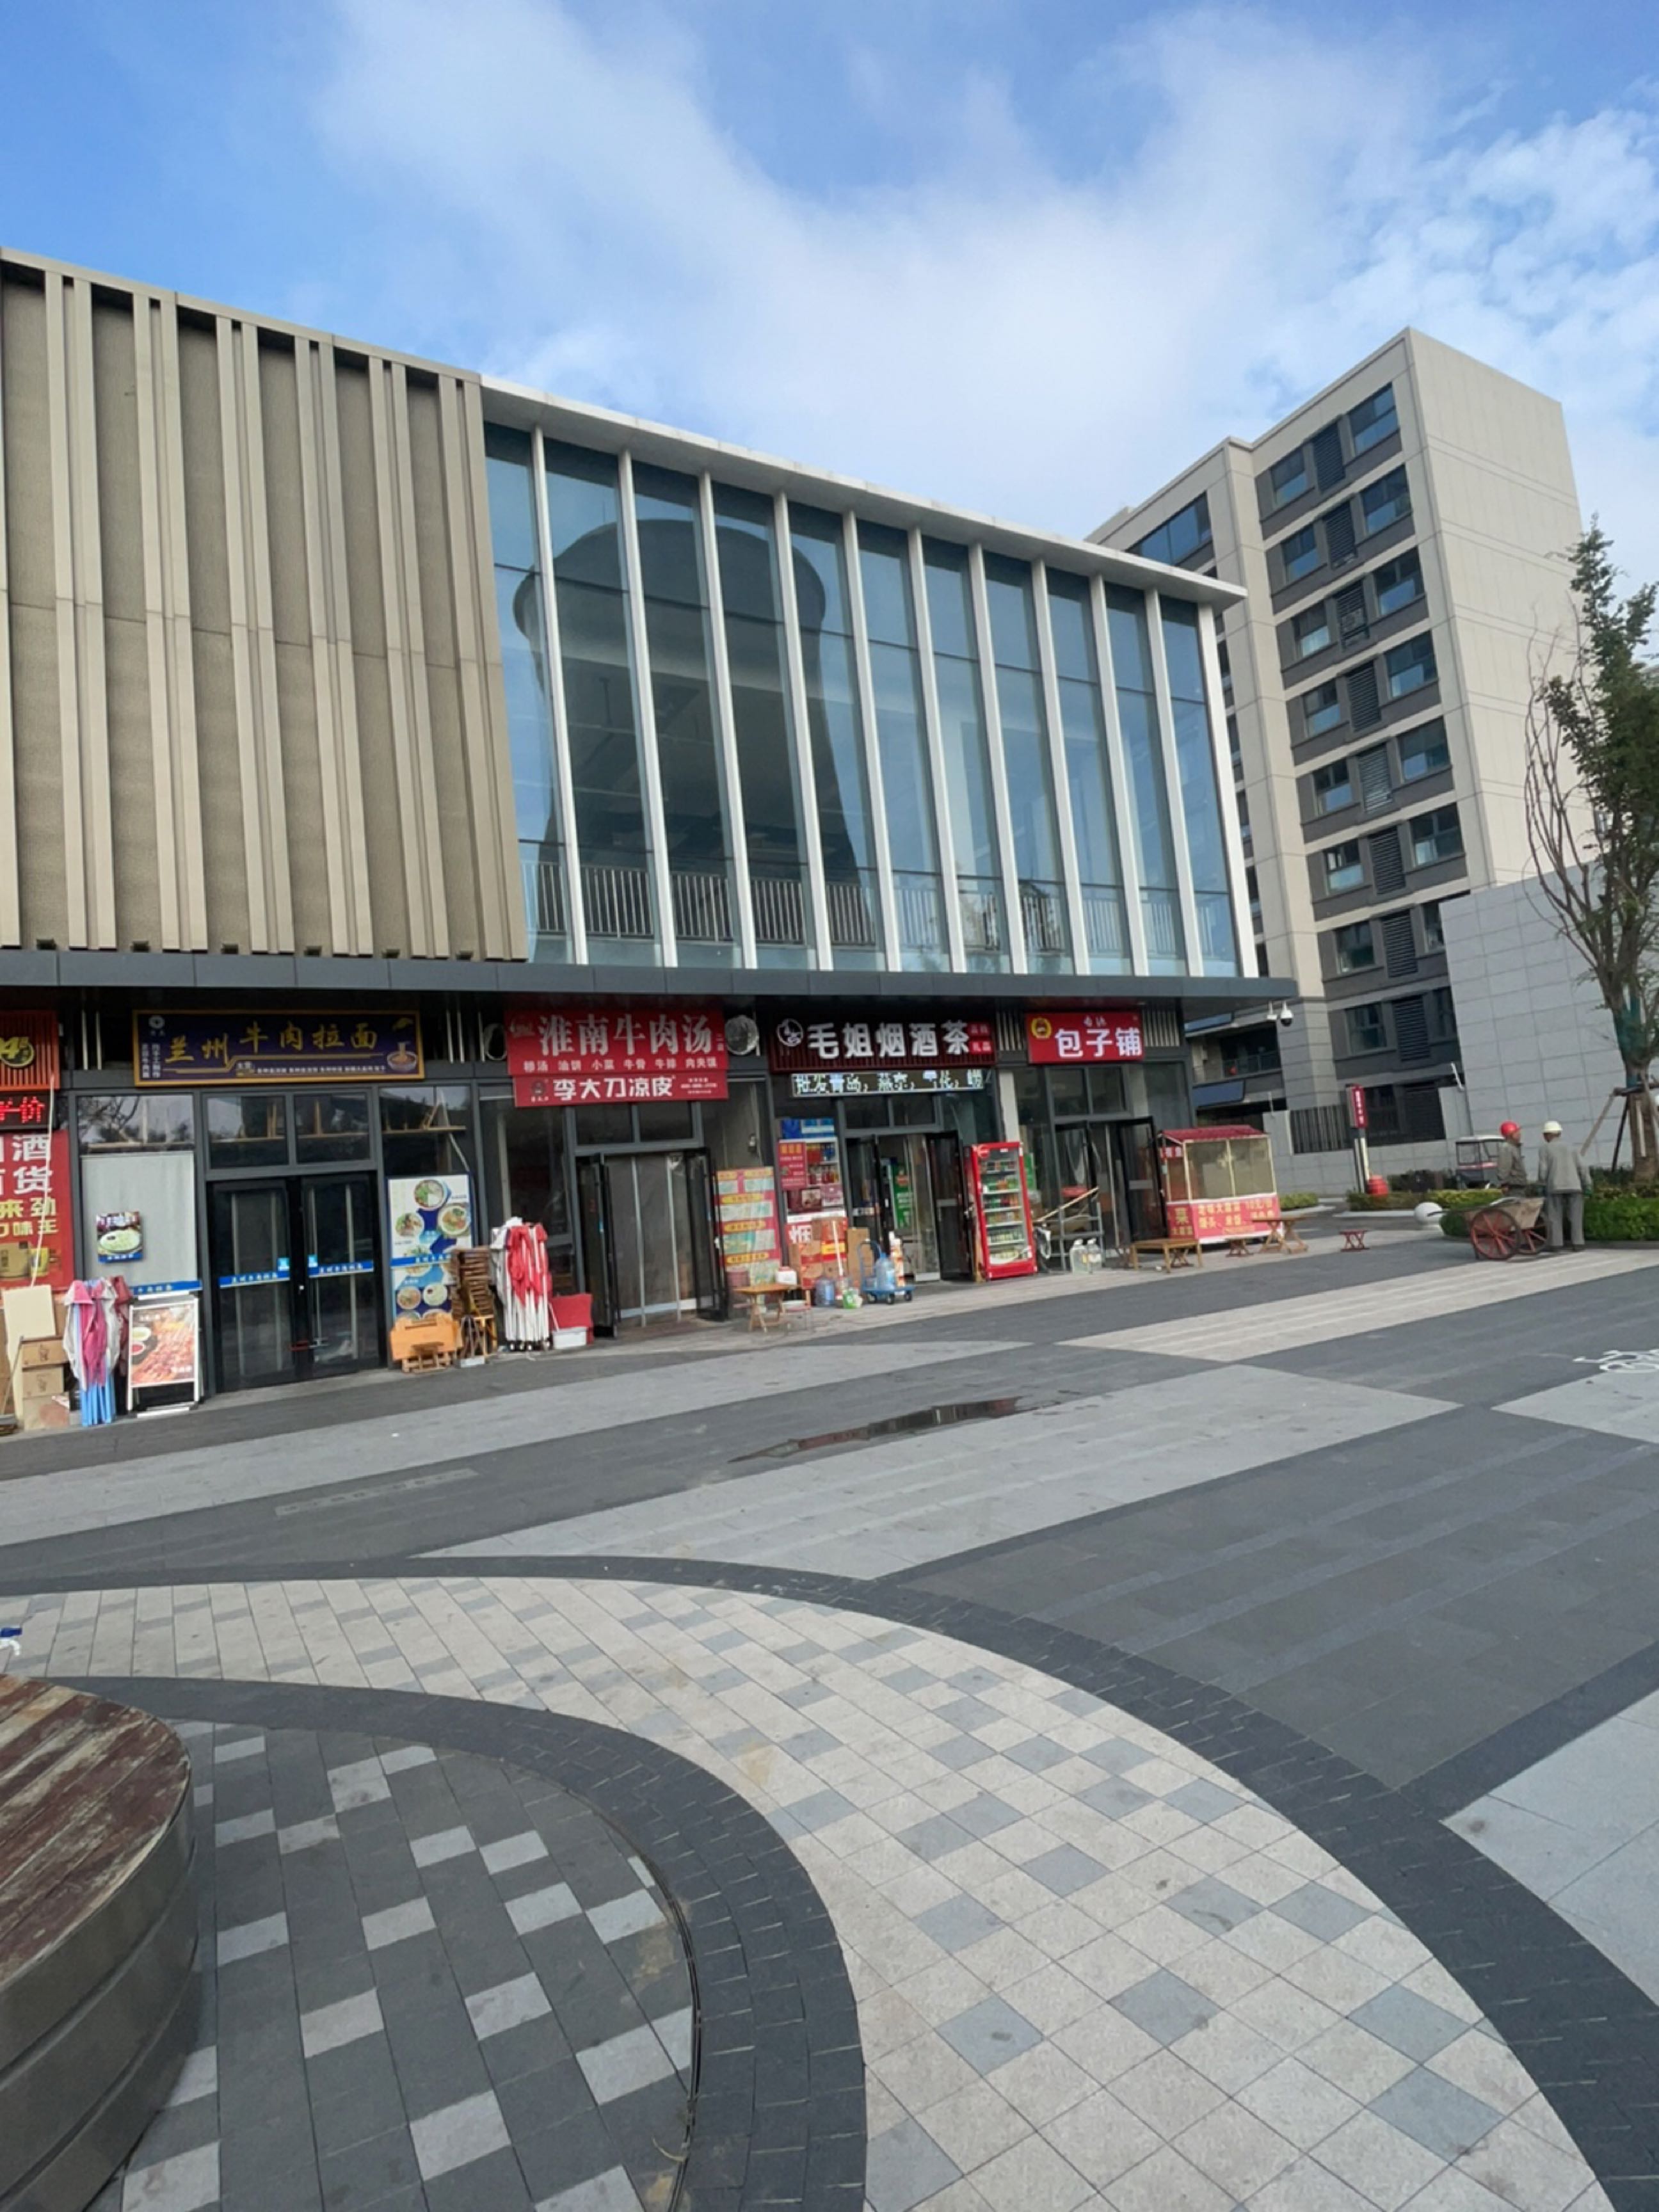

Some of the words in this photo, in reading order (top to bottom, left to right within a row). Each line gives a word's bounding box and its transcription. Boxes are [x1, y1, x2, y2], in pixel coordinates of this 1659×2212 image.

[164, 1020, 378, 1065] 兰州牛肉拉面
[538, 1014, 712, 1056] 淮南牛肉汤
[807, 1020, 970, 1059] 毛姐烟酒茶
[1055, 1027, 1142, 1057] 包子铺
[552, 1076, 673, 1101] 李大刀凉皮
[0, 1134, 51, 1162] 酒
